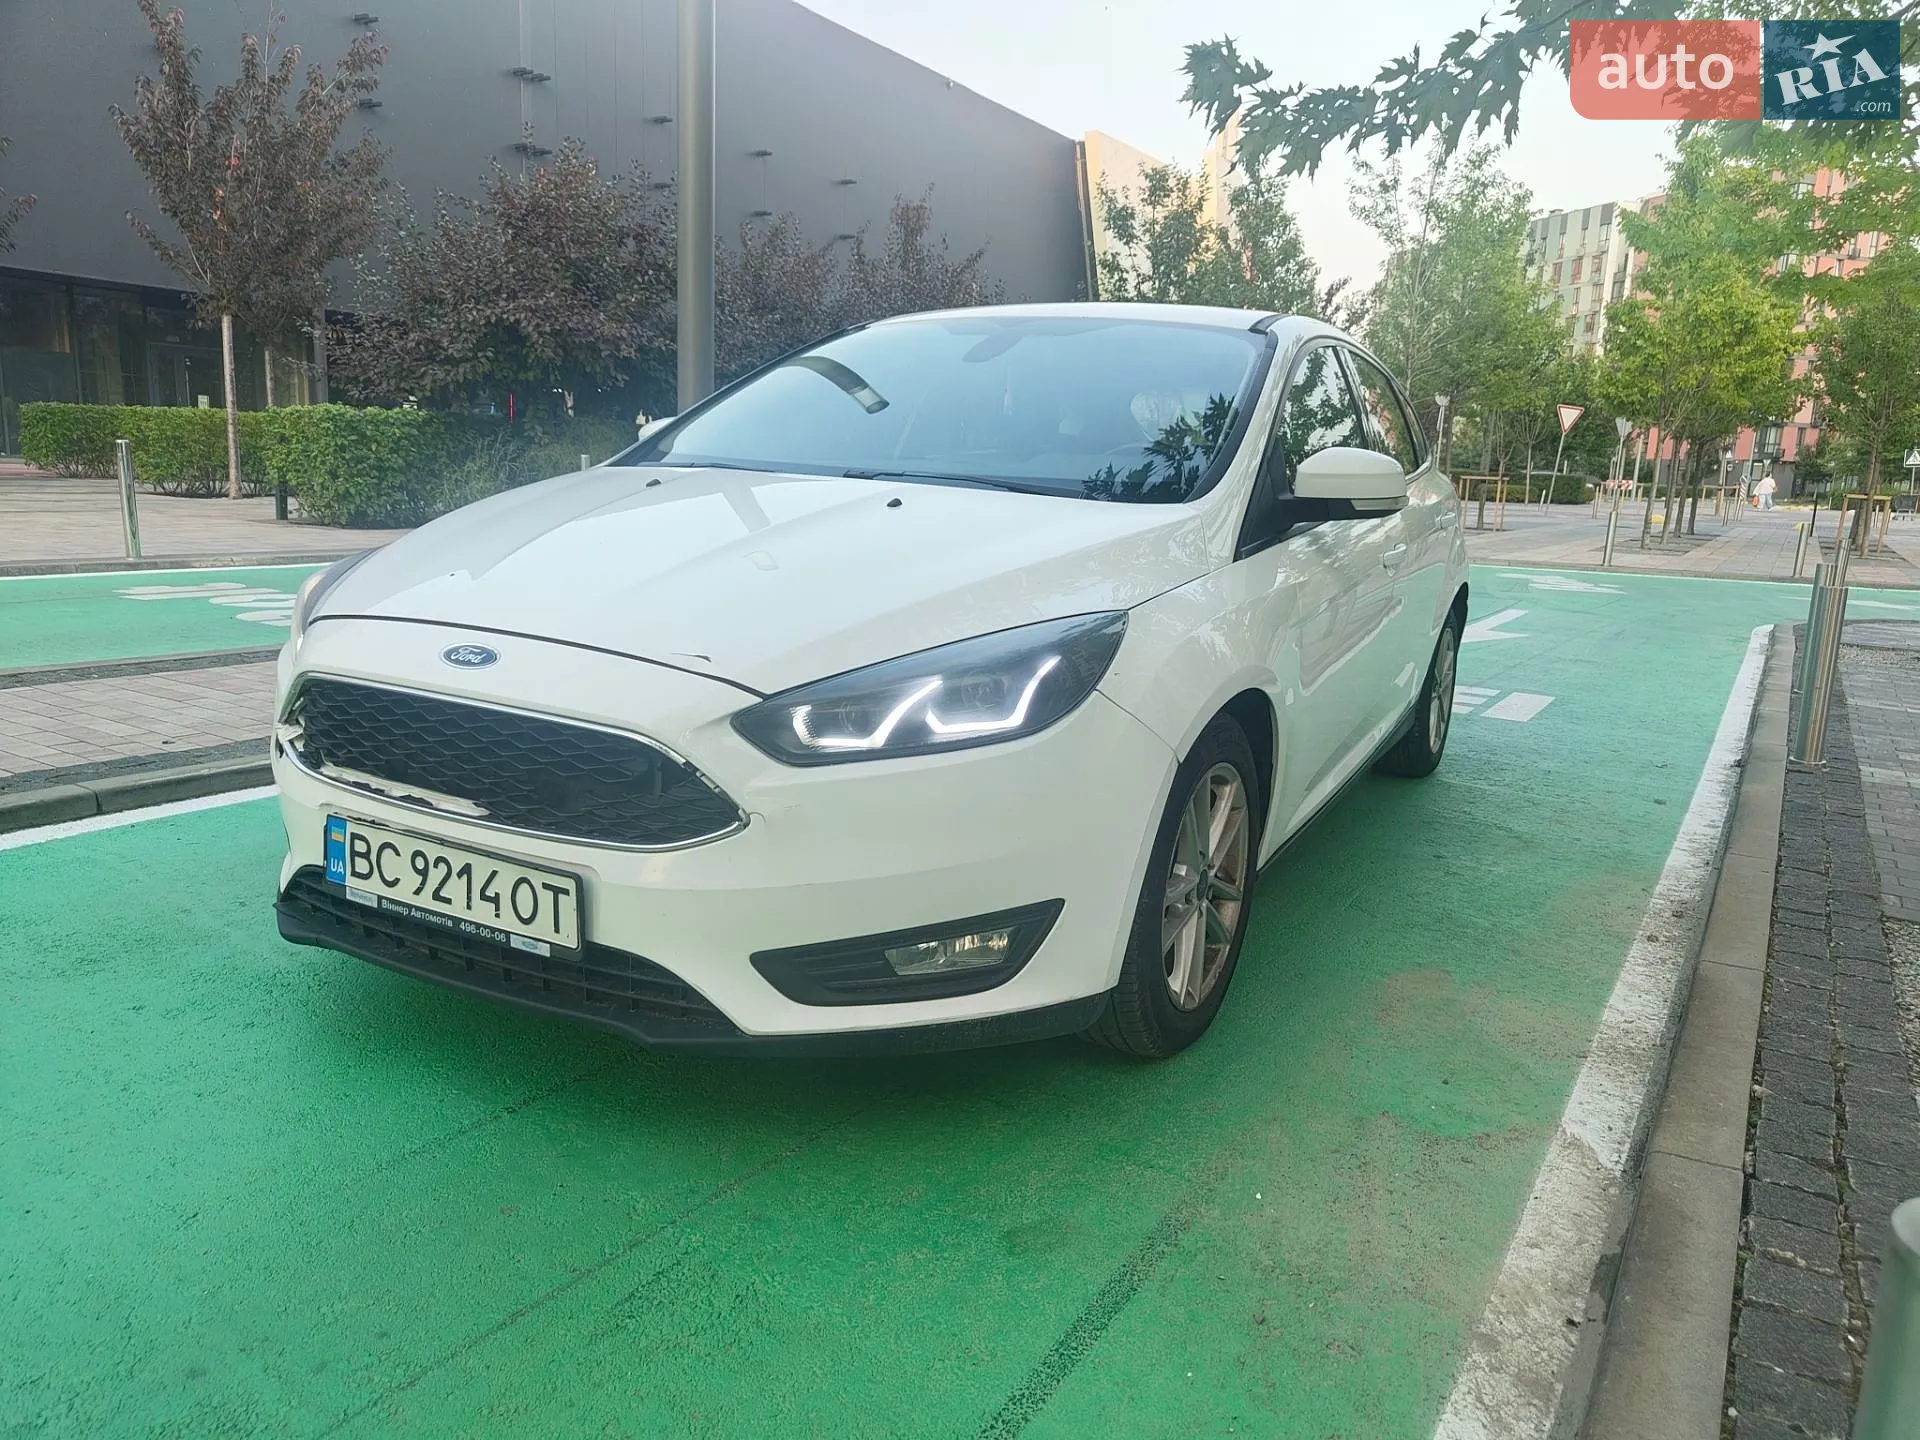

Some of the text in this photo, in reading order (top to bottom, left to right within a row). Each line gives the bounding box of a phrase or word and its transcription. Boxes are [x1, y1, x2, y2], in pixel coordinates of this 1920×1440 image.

[450, 646, 487, 664] Ford
[330, 860, 345, 875] UA
[459, 921, 507, 943] 496-00-06
